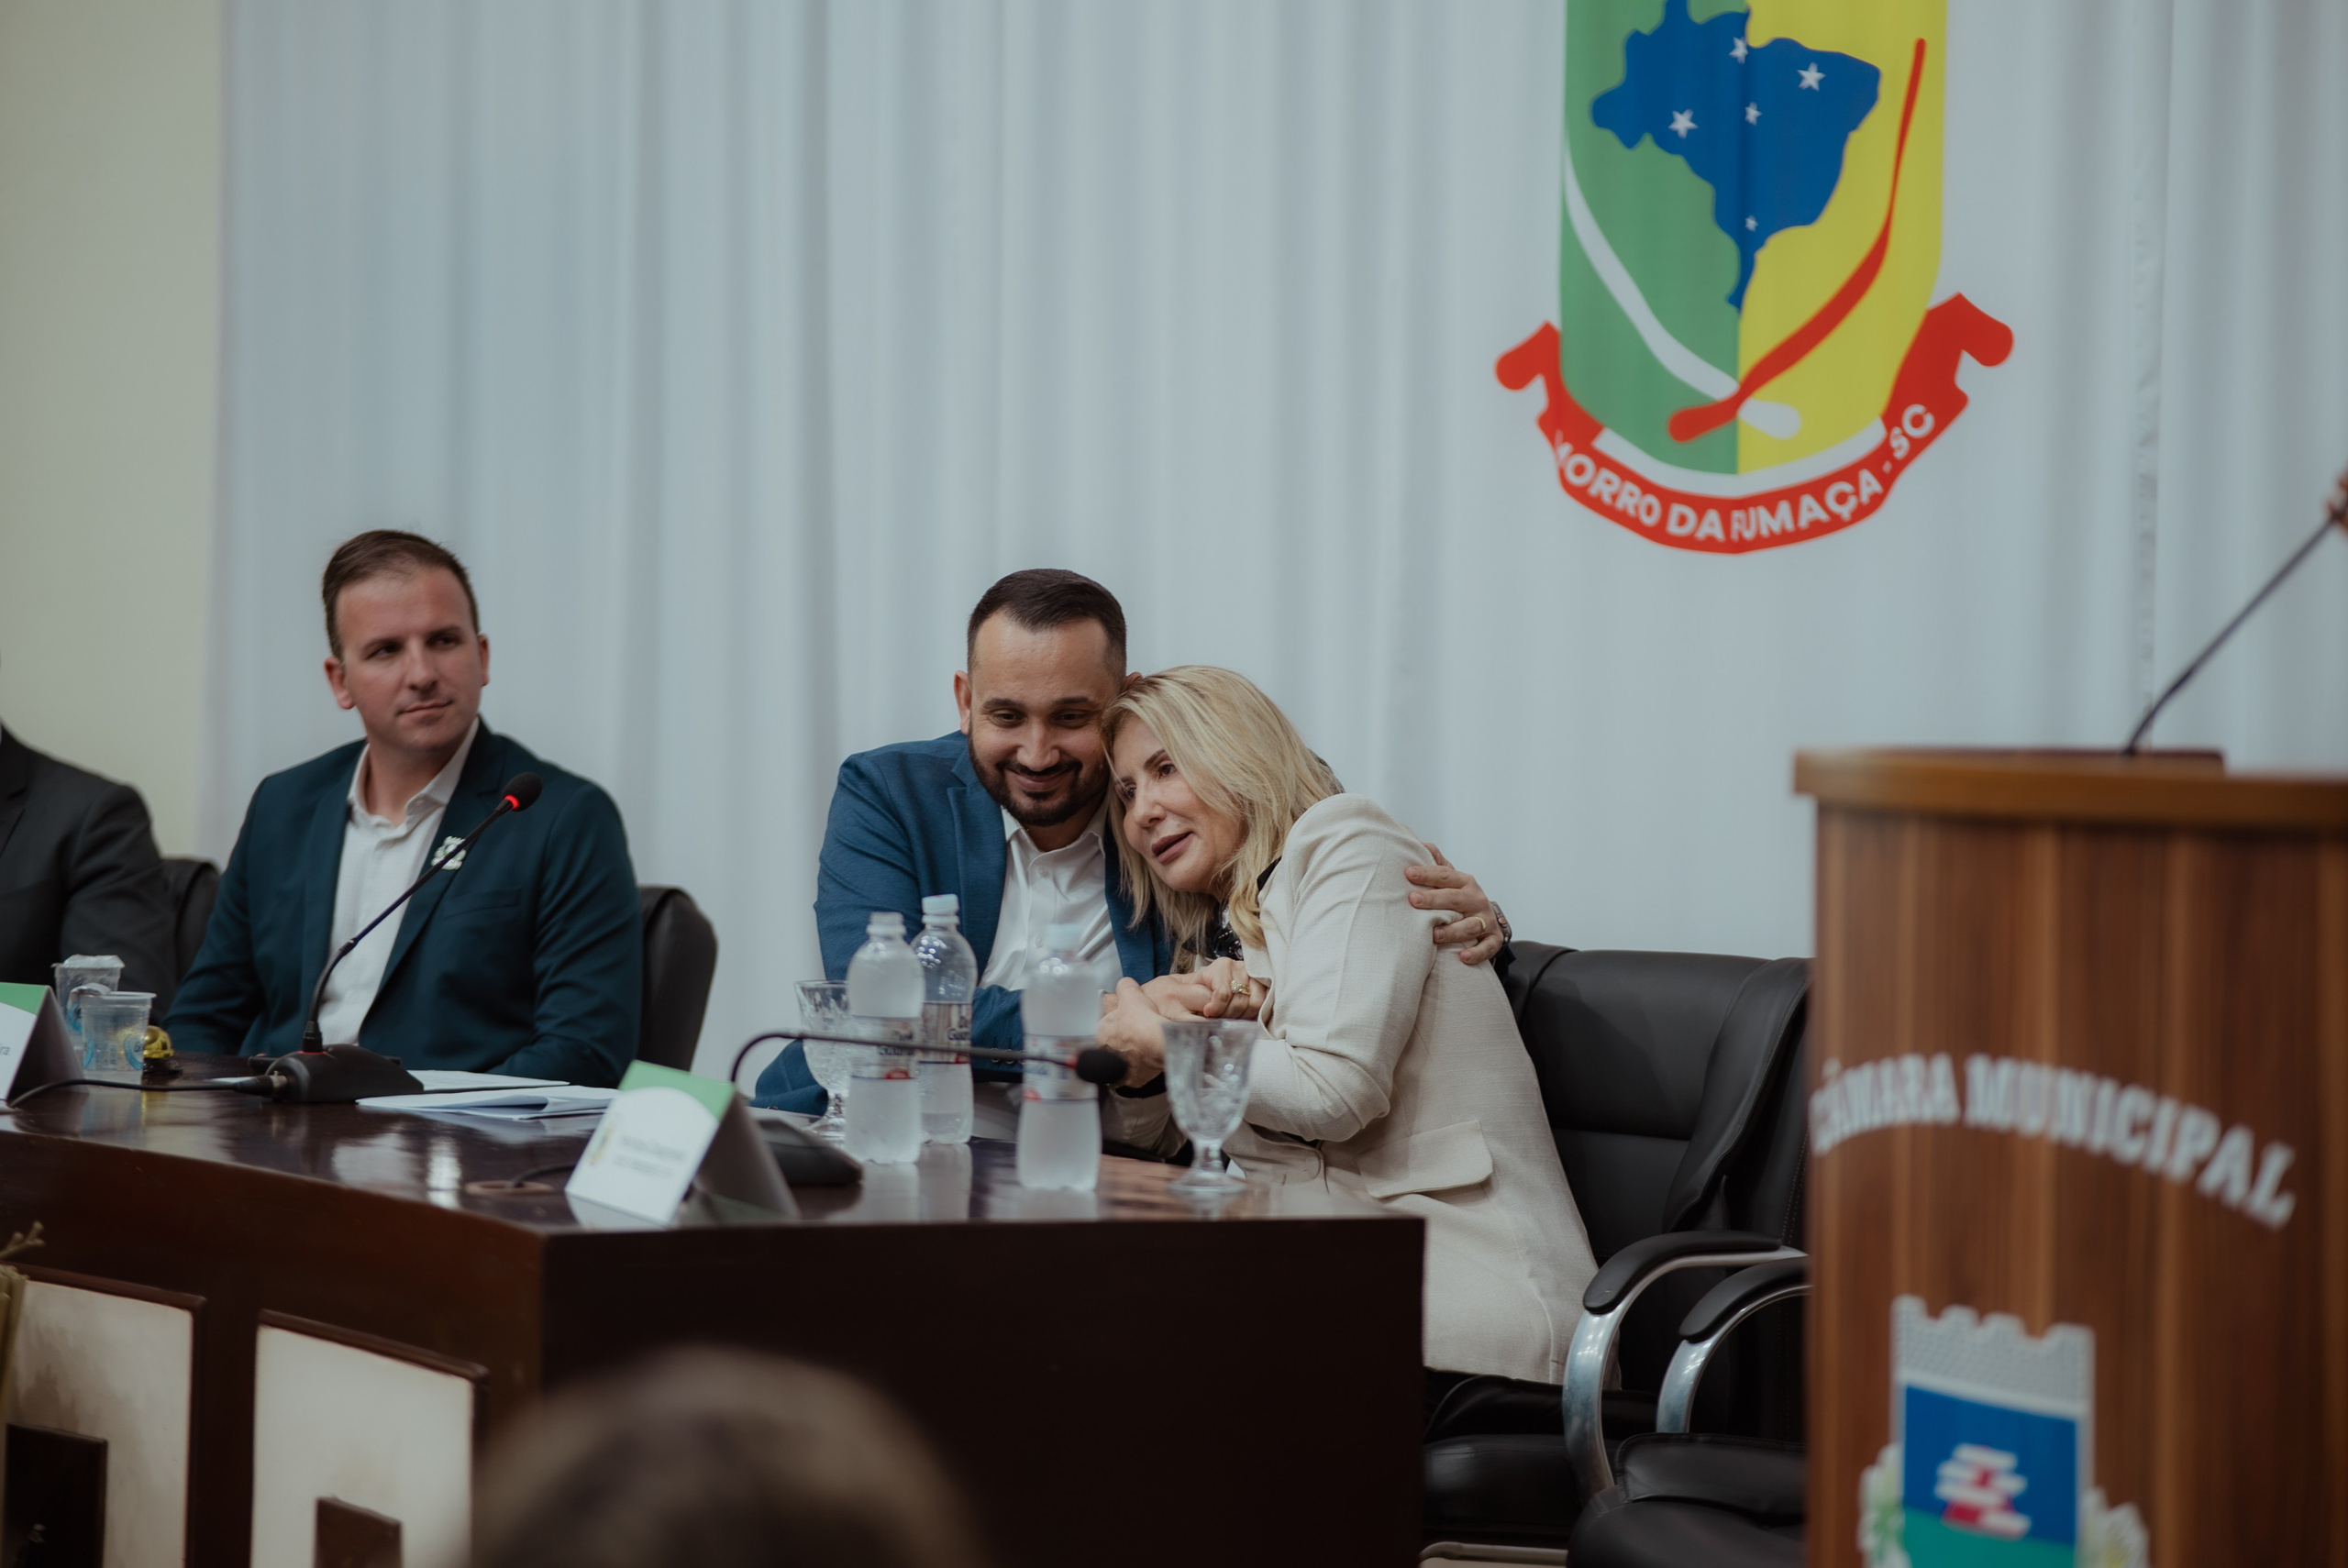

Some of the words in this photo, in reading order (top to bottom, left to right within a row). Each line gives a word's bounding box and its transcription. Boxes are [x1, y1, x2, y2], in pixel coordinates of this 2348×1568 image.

[1666, 502, 1726, 542] DA
[1730, 468, 1884, 542] FUMAÇA
[1888, 403, 1936, 460] SC
[1963, 1051, 2296, 1231] MUNICIPAL
